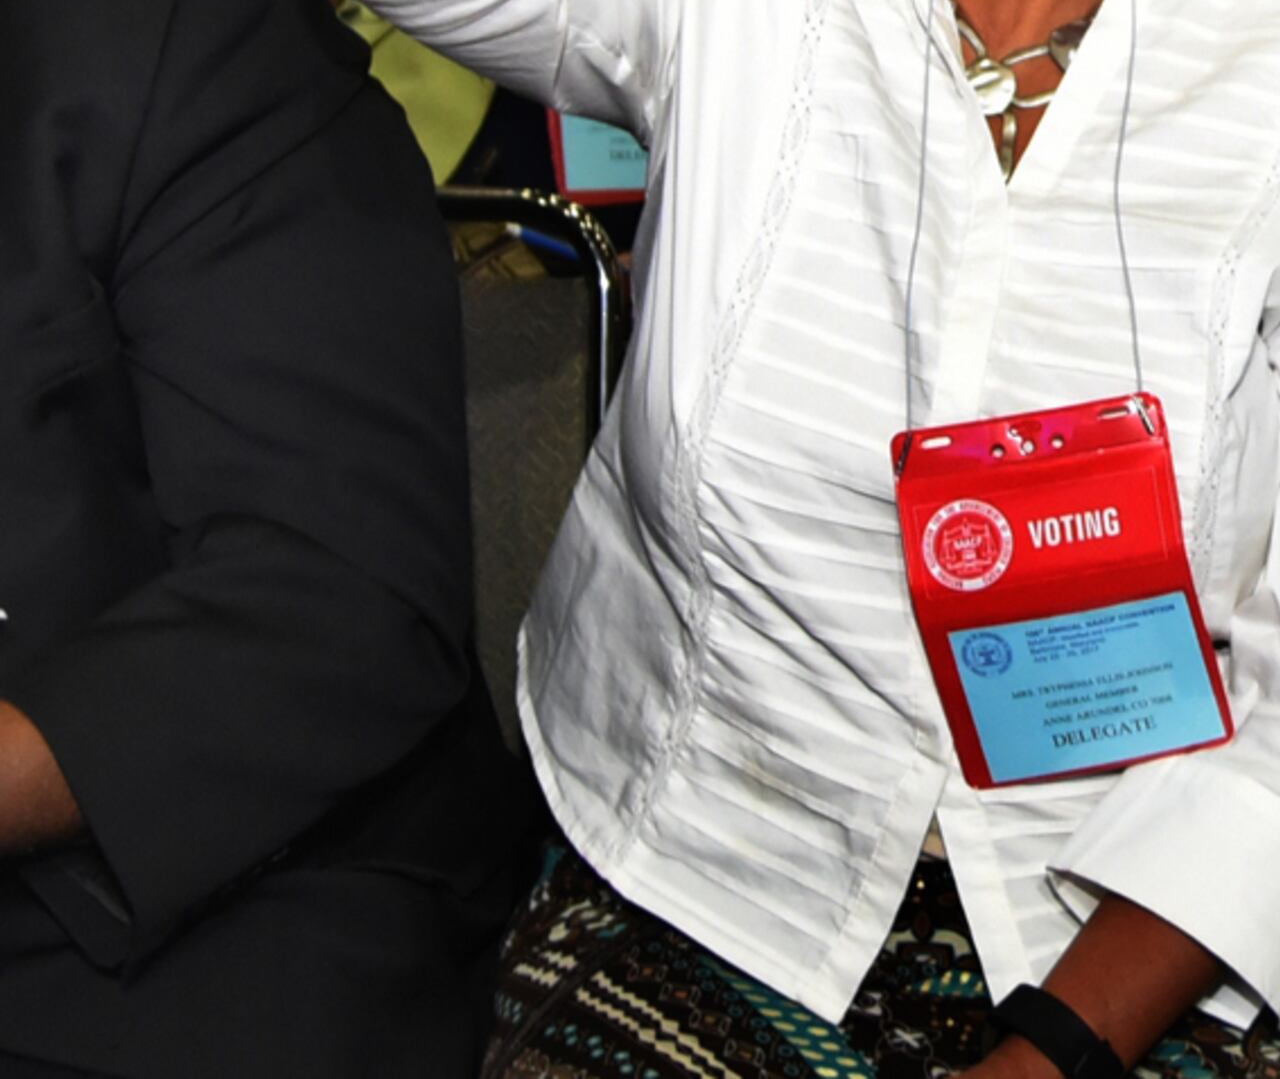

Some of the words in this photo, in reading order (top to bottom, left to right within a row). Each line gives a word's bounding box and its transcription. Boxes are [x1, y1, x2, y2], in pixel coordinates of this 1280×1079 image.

[1028, 507, 1121, 549] VOTING
[1046, 696, 1090, 708] GENERAL
[1095, 686, 1138, 699] MEMBER
[1052, 716, 1157, 748] DELEGATE
